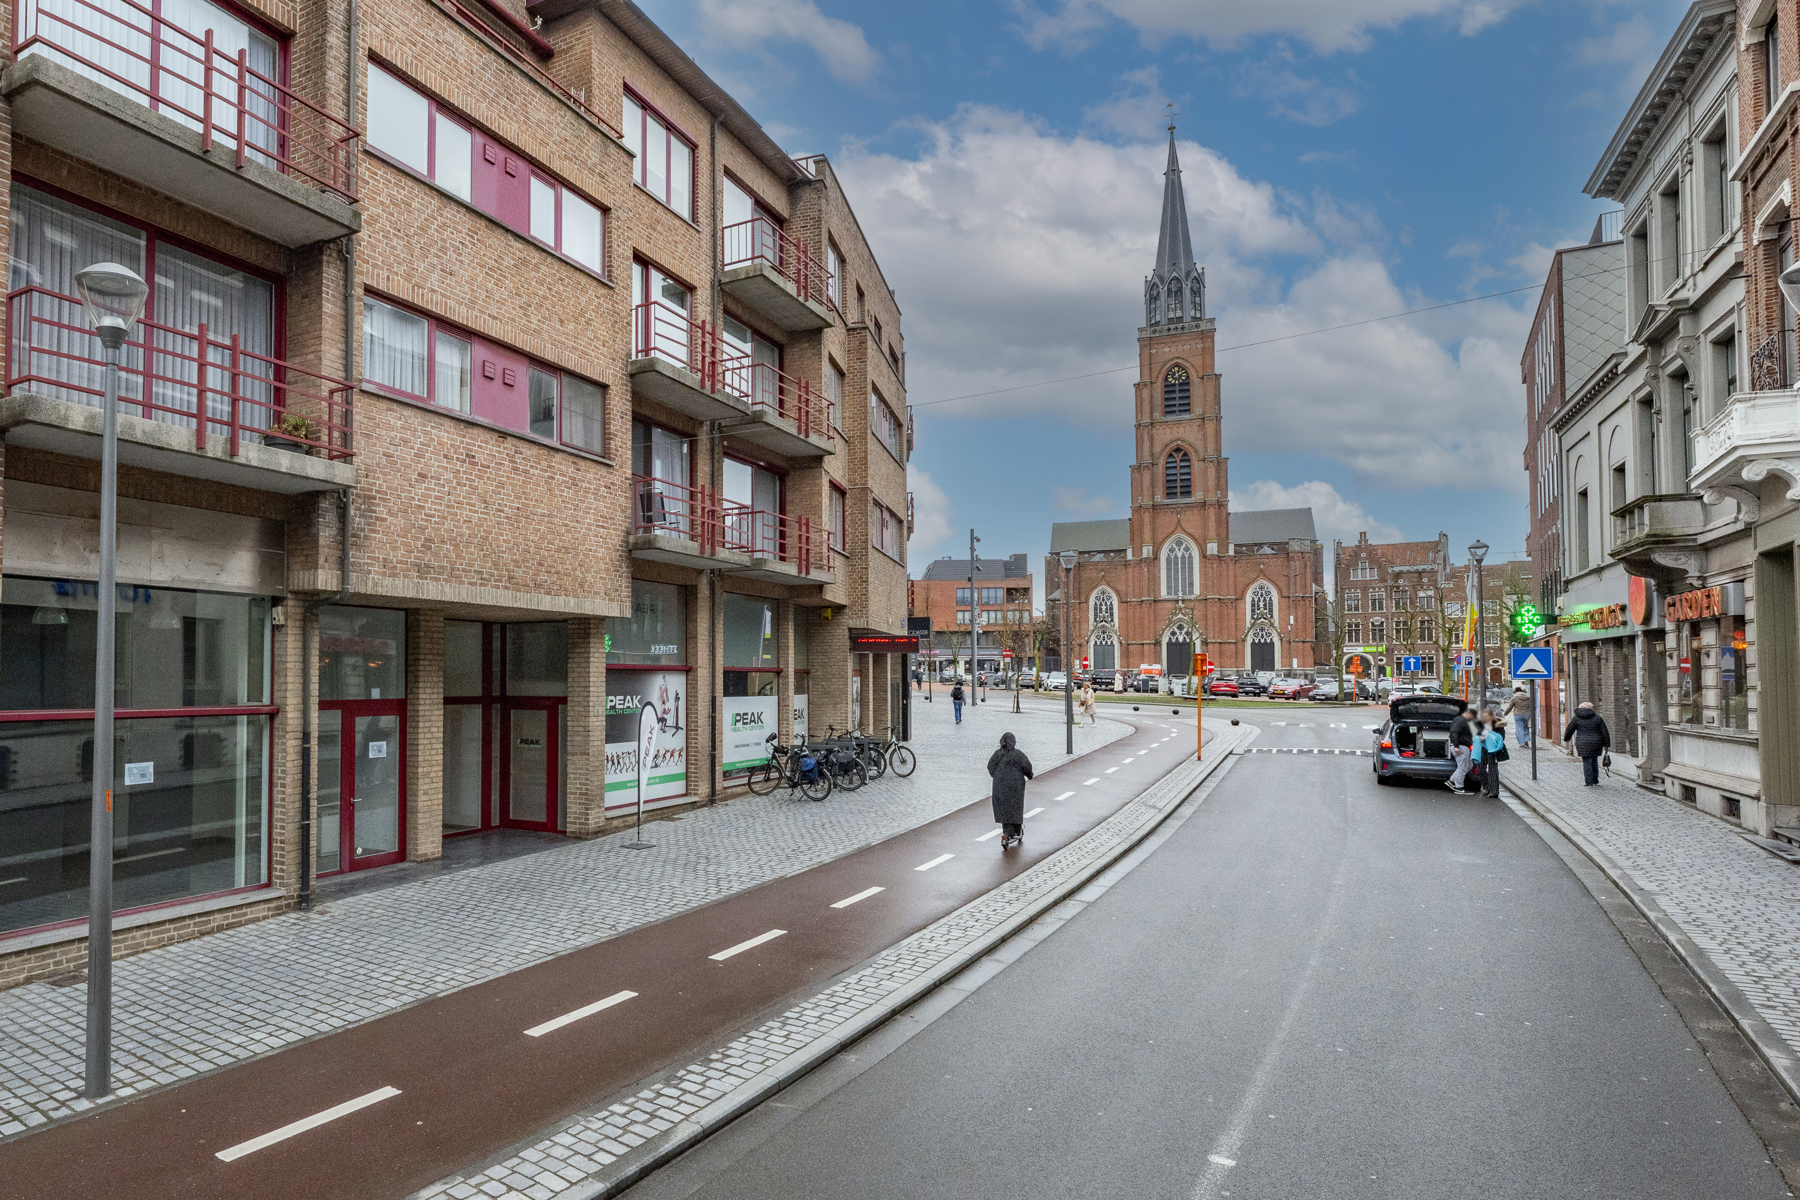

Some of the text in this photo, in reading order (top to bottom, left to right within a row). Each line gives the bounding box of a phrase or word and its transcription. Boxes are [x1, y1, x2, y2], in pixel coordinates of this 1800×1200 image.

[1665, 585, 1722, 623] GARDEN
[1465, 657, 1472, 665] P
[607, 694, 642, 709] PEAK
[733, 711, 764, 726] PEAK
[794, 708, 805, 720] EAK
[642, 724, 655, 768] PEAK
